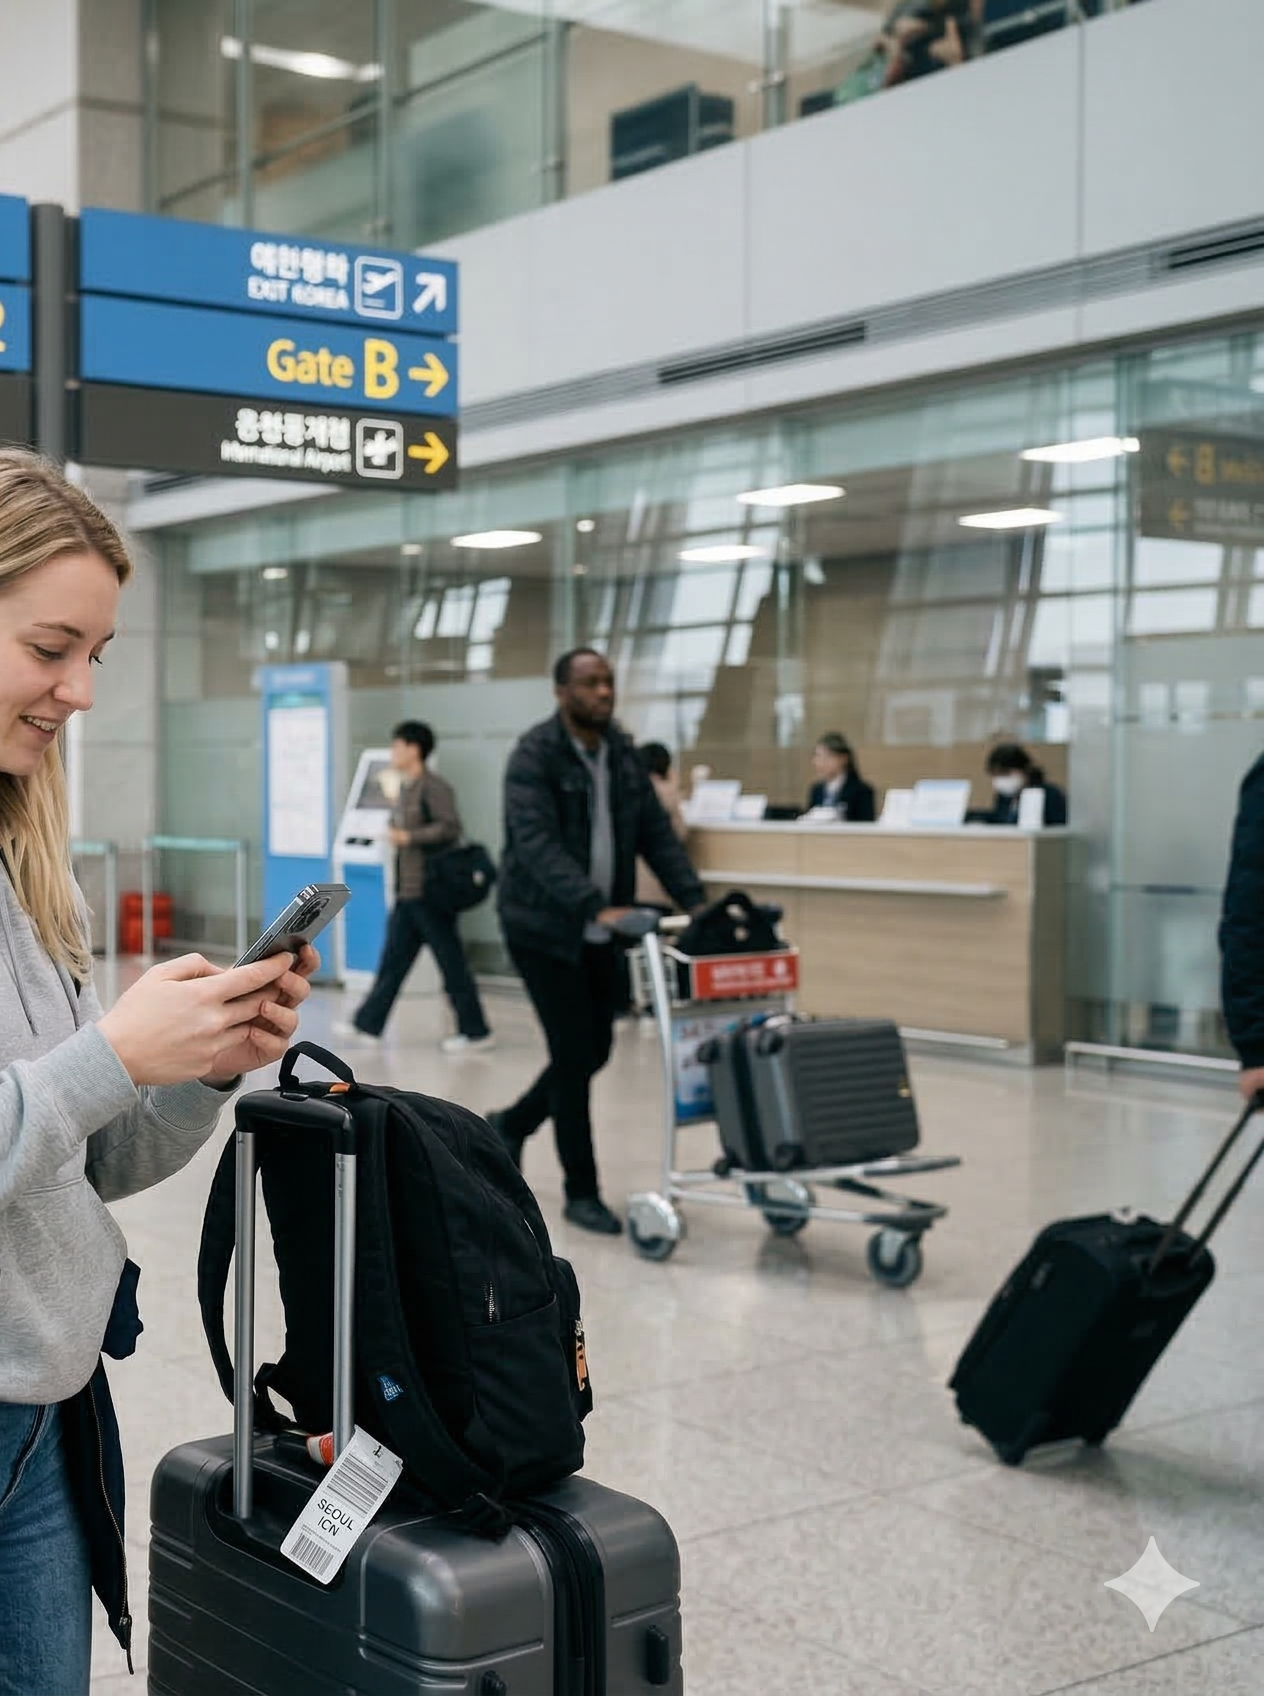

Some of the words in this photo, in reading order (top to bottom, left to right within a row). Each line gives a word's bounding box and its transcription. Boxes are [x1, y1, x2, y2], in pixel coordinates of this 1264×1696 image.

[267, 338, 354, 388] Gate
[364, 338, 400, 399] B
[317, 1498, 354, 1531] SEOUL
[317, 1516, 341, 1537] ICN
